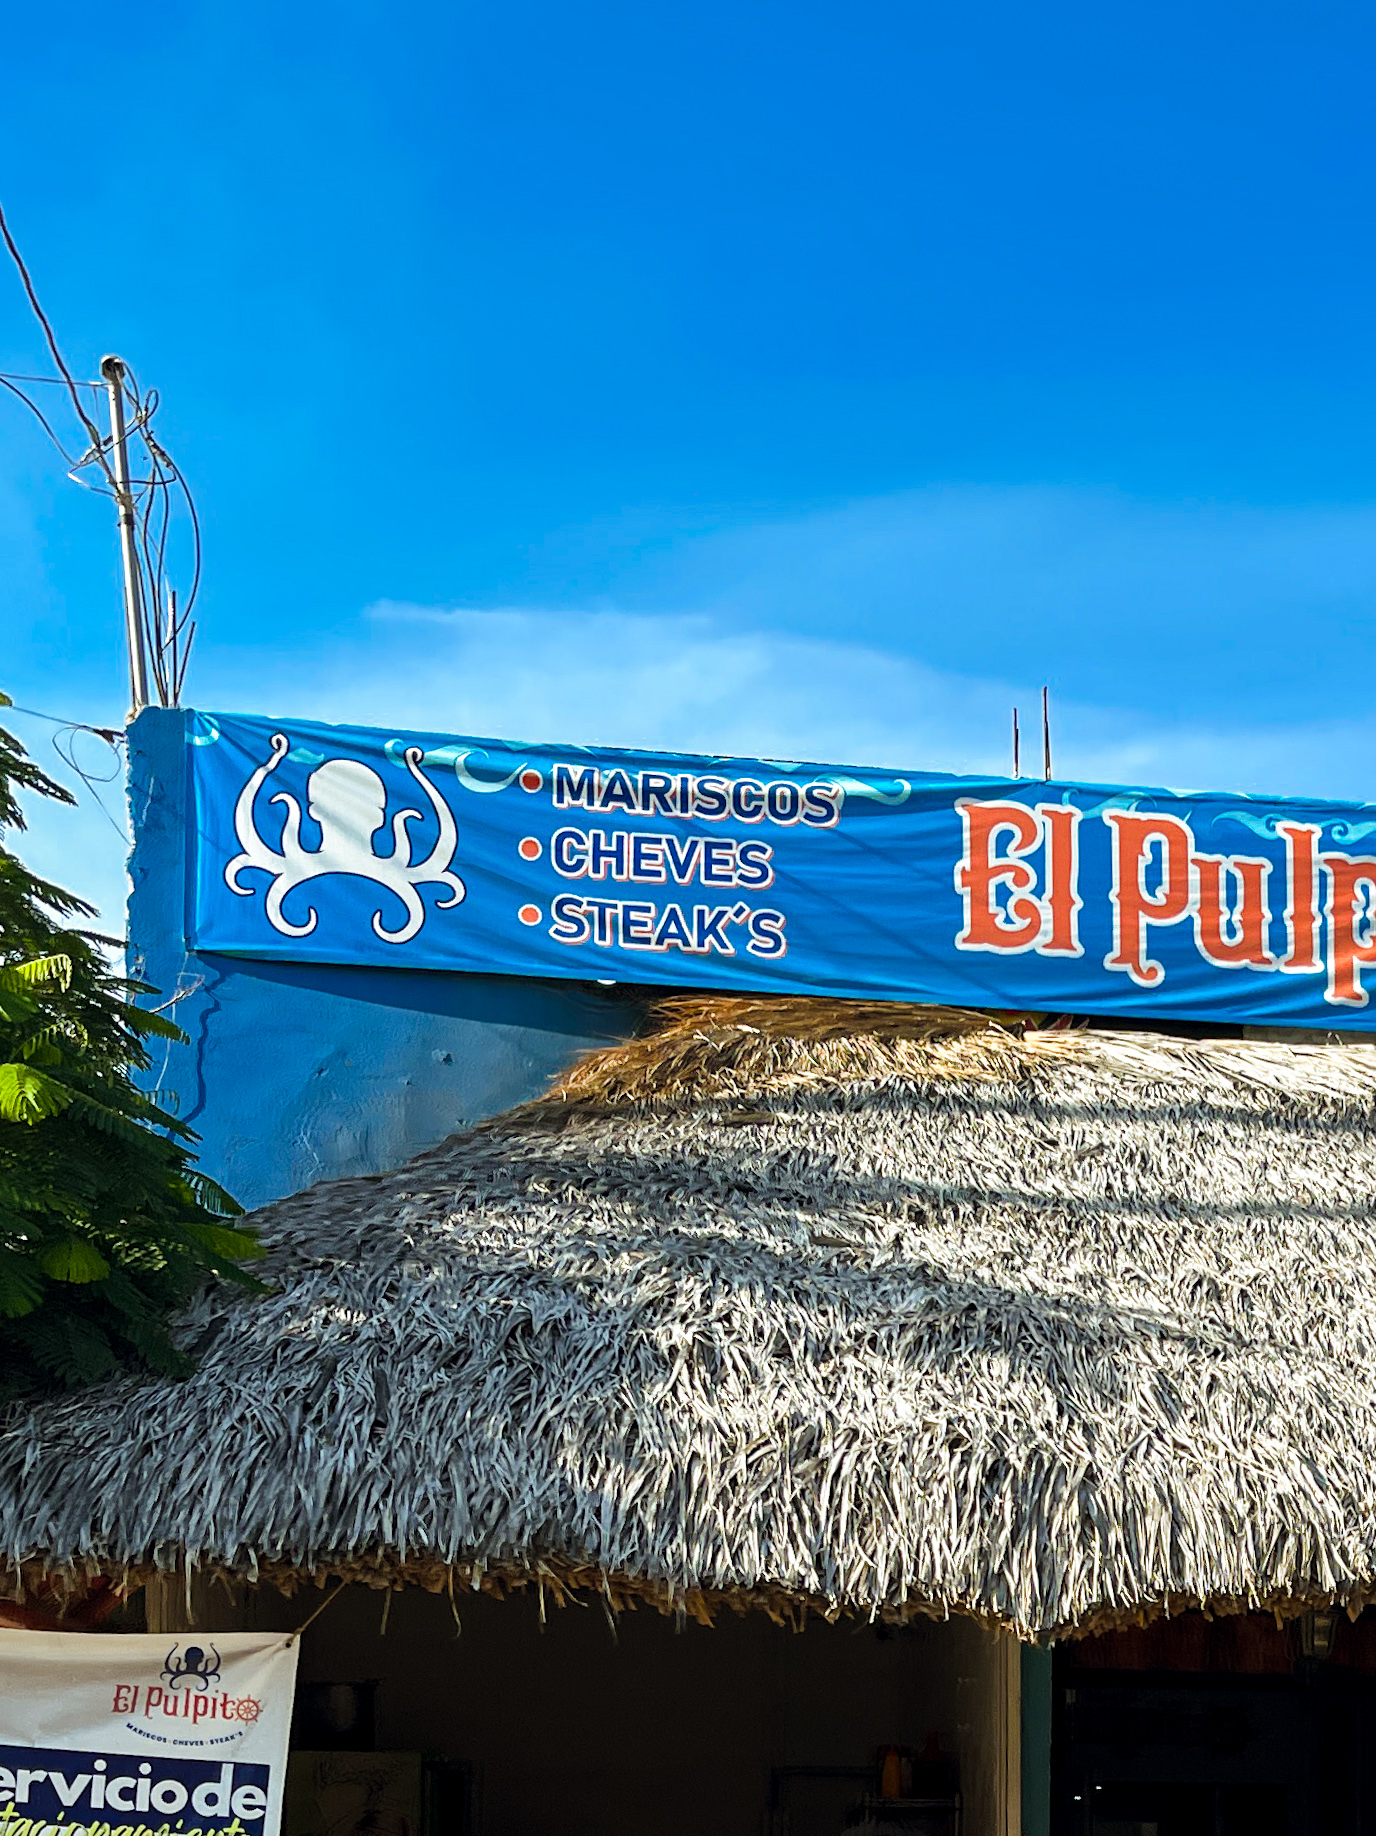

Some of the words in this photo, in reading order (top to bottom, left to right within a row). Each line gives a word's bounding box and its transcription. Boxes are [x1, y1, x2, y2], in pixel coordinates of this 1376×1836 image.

[551, 763, 840, 827] MARISCOS
[550, 827, 774, 890] CHEVES
[954, 798, 1085, 957] El
[548, 894, 786, 957] STEAK'S
[111, 1684, 139, 1713] El
[144, 1686, 263, 1726] Pulpito
[126, 1722, 167, 1743] MARISCOS
[191, 1763, 267, 1821] de
